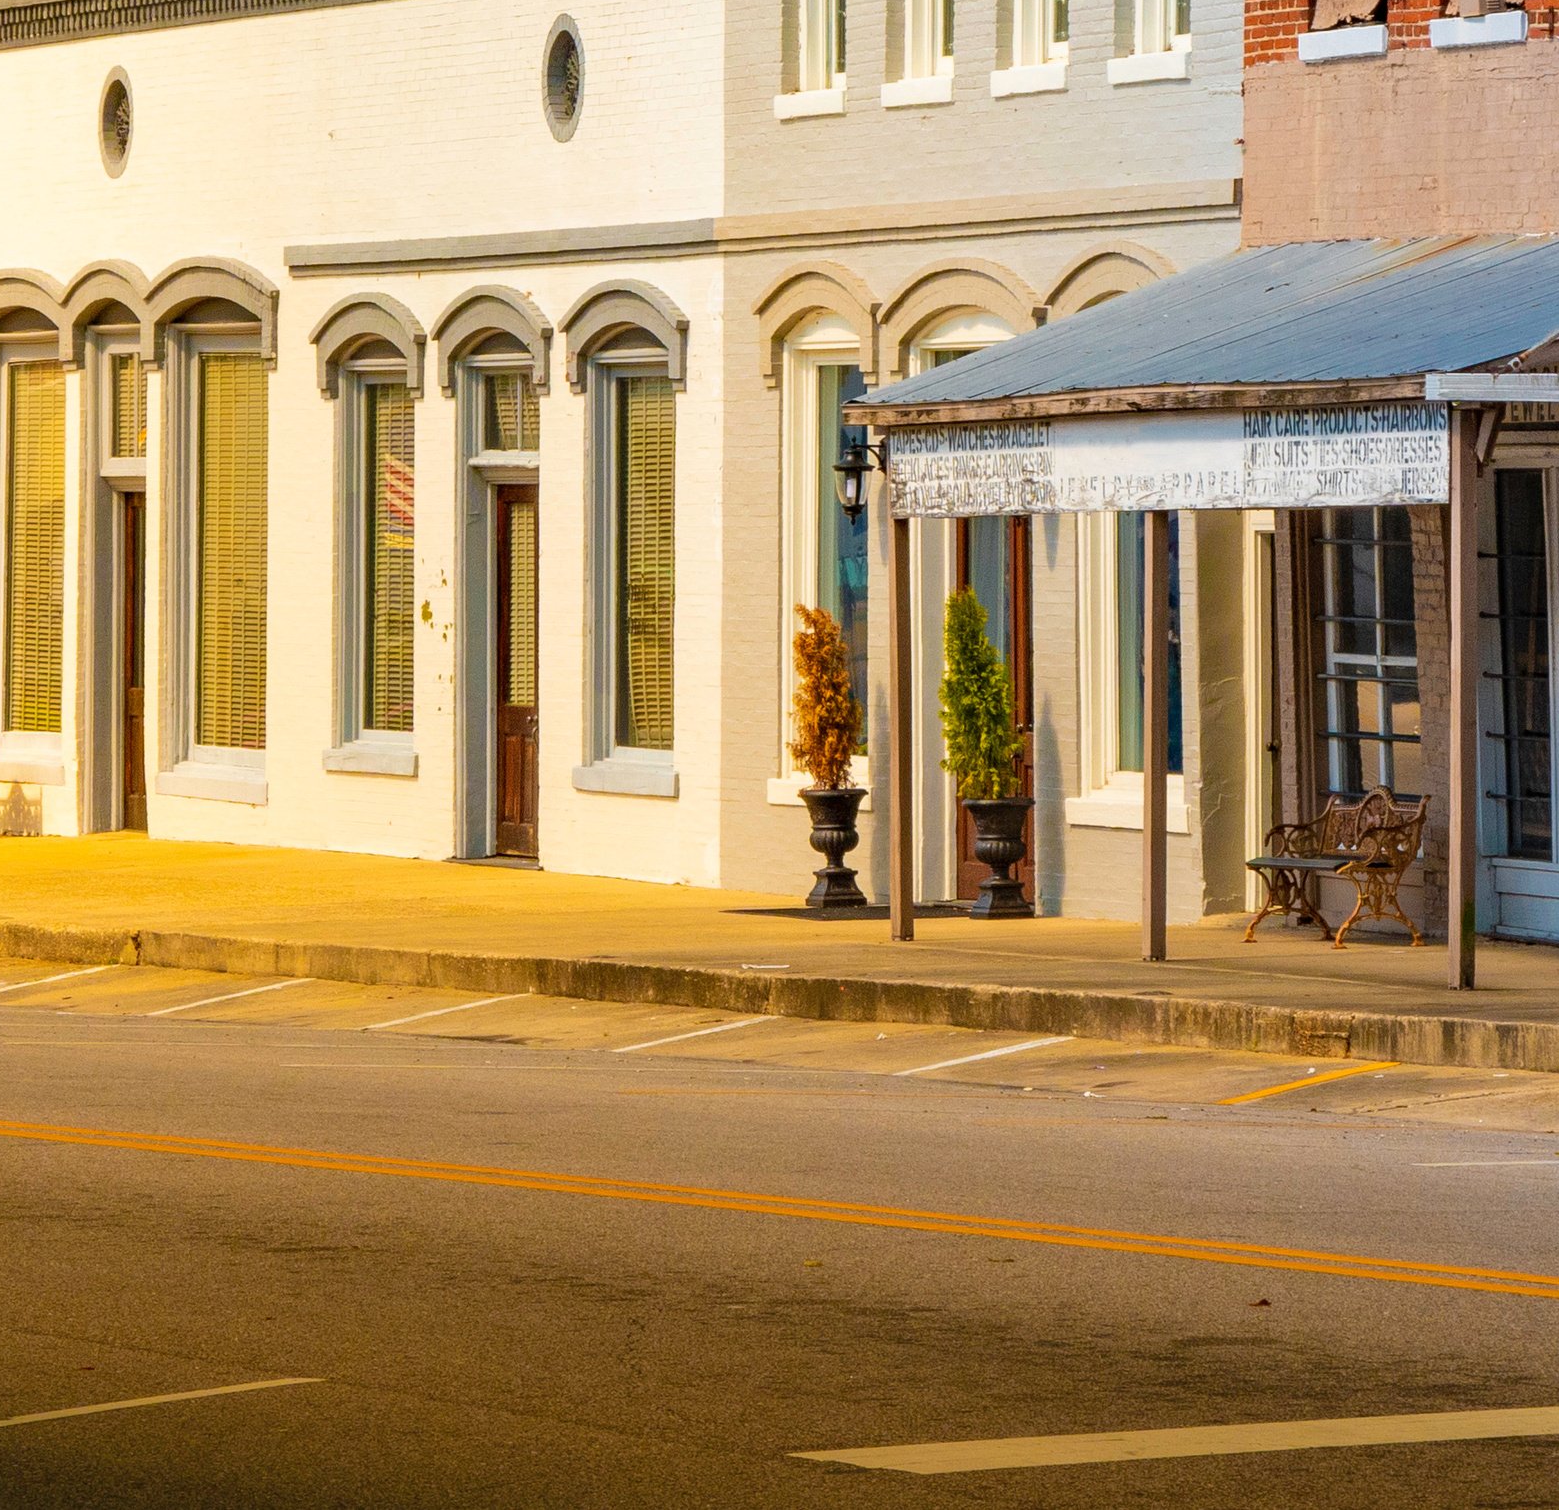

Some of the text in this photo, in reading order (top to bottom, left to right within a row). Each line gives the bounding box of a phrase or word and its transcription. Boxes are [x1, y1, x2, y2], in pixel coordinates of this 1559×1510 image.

[1244, 410, 1272, 438] HAIR
[1275, 408, 1309, 437] CARE
[1312, 404, 1379, 435] PRODUCTS
[1274, 439, 1309, 468] SUITS
